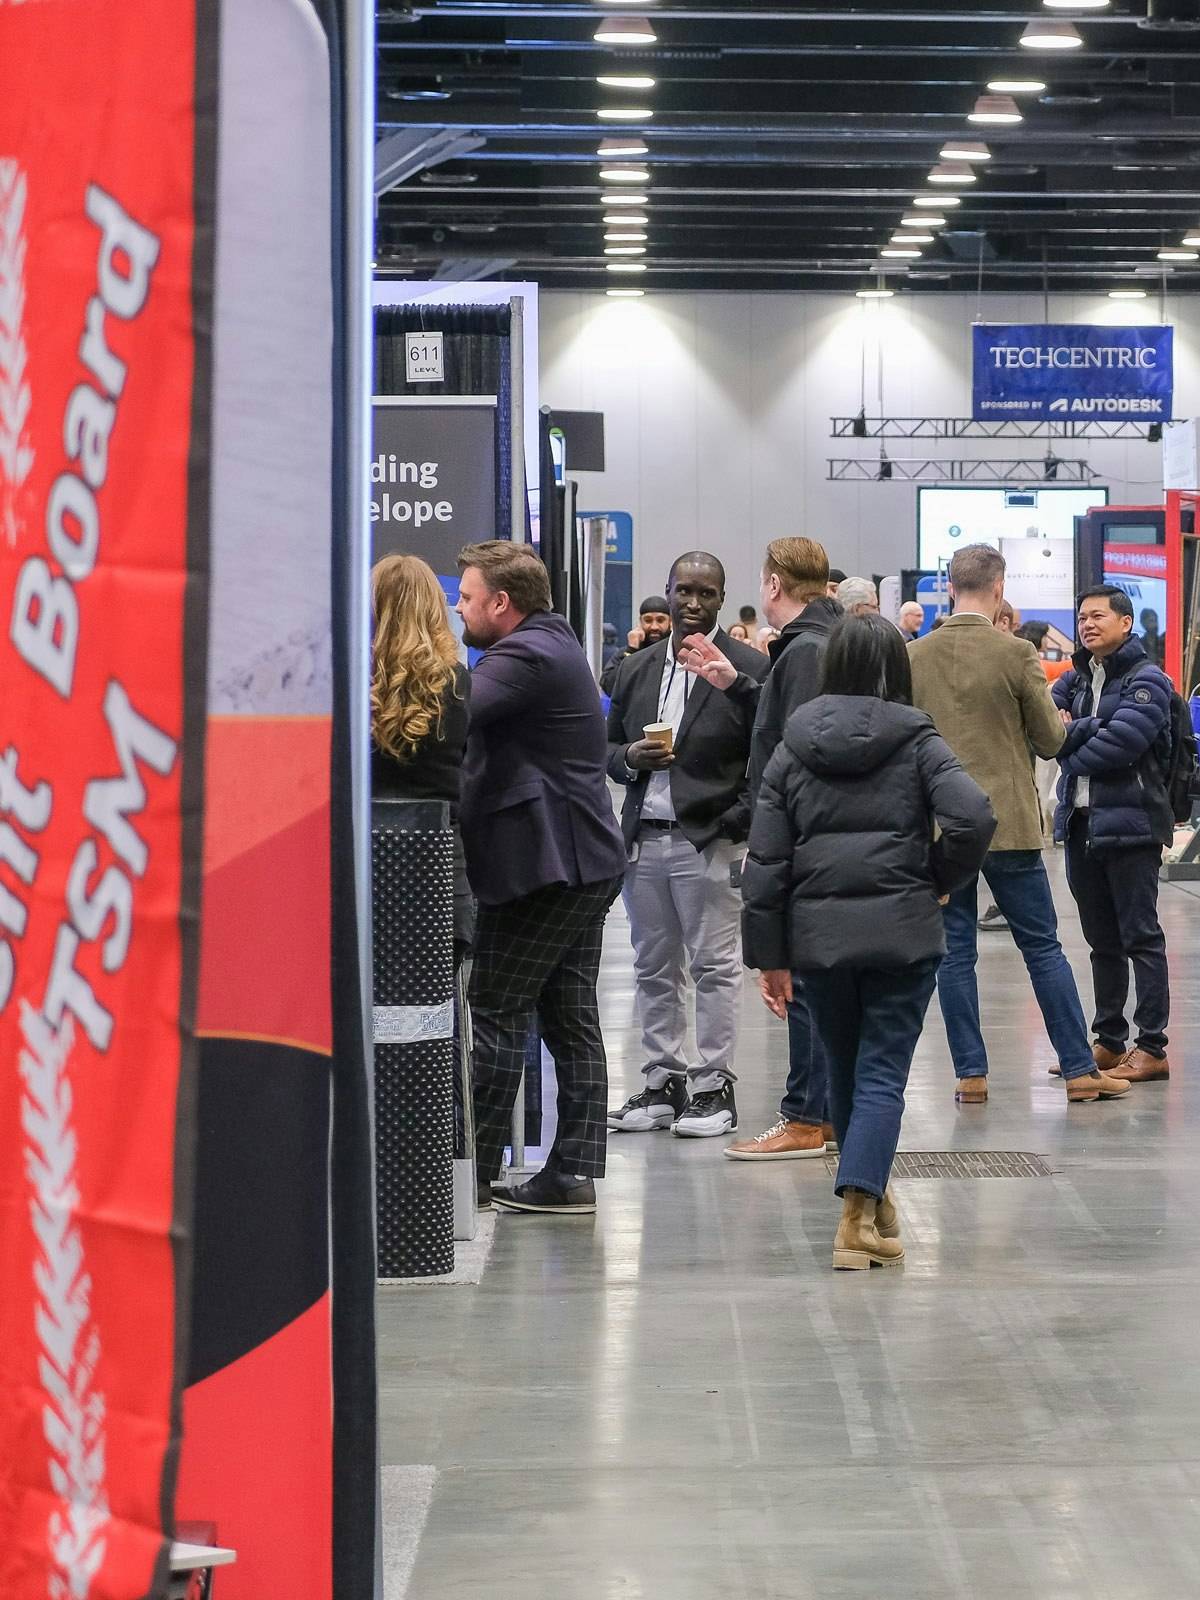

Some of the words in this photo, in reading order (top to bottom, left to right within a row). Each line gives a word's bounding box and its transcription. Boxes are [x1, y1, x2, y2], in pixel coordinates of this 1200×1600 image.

[410, 346, 438, 361] 611
[990, 347, 1157, 369] TECHCENTRIC
[1071, 398, 1163, 413] AUTODESK
[9, 180, 161, 700] Board
[370, 454, 438, 488] ding
[43, 678, 178, 1053] TSM
